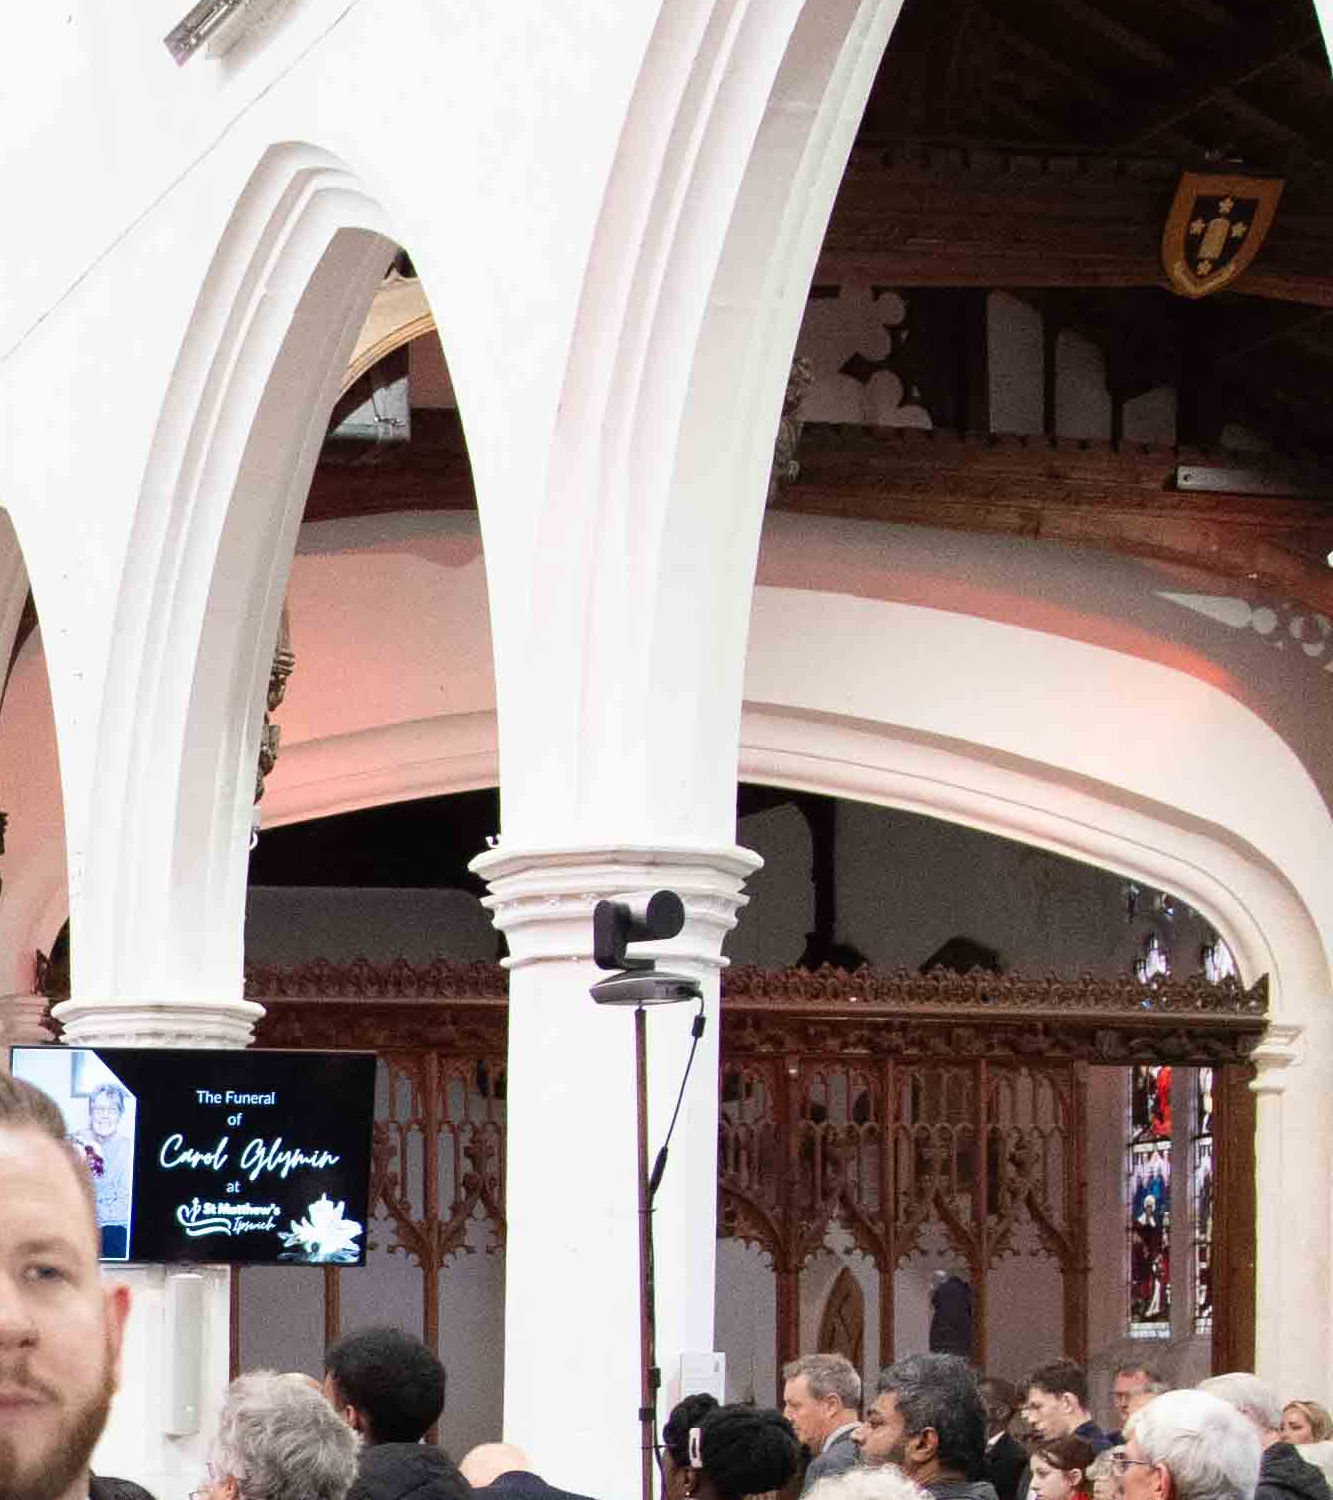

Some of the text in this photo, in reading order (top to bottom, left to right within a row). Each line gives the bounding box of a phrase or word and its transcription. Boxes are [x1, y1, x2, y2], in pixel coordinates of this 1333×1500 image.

[196, 1089, 277, 1106] The Funeral
[227, 1112, 243, 1126] of
[159, 1133, 229, 1171] Carol
[226, 1180, 241, 1194] at
[202, 1202, 281, 1216] St Matthew's
[232, 1216, 277, 1235] Ipswich
